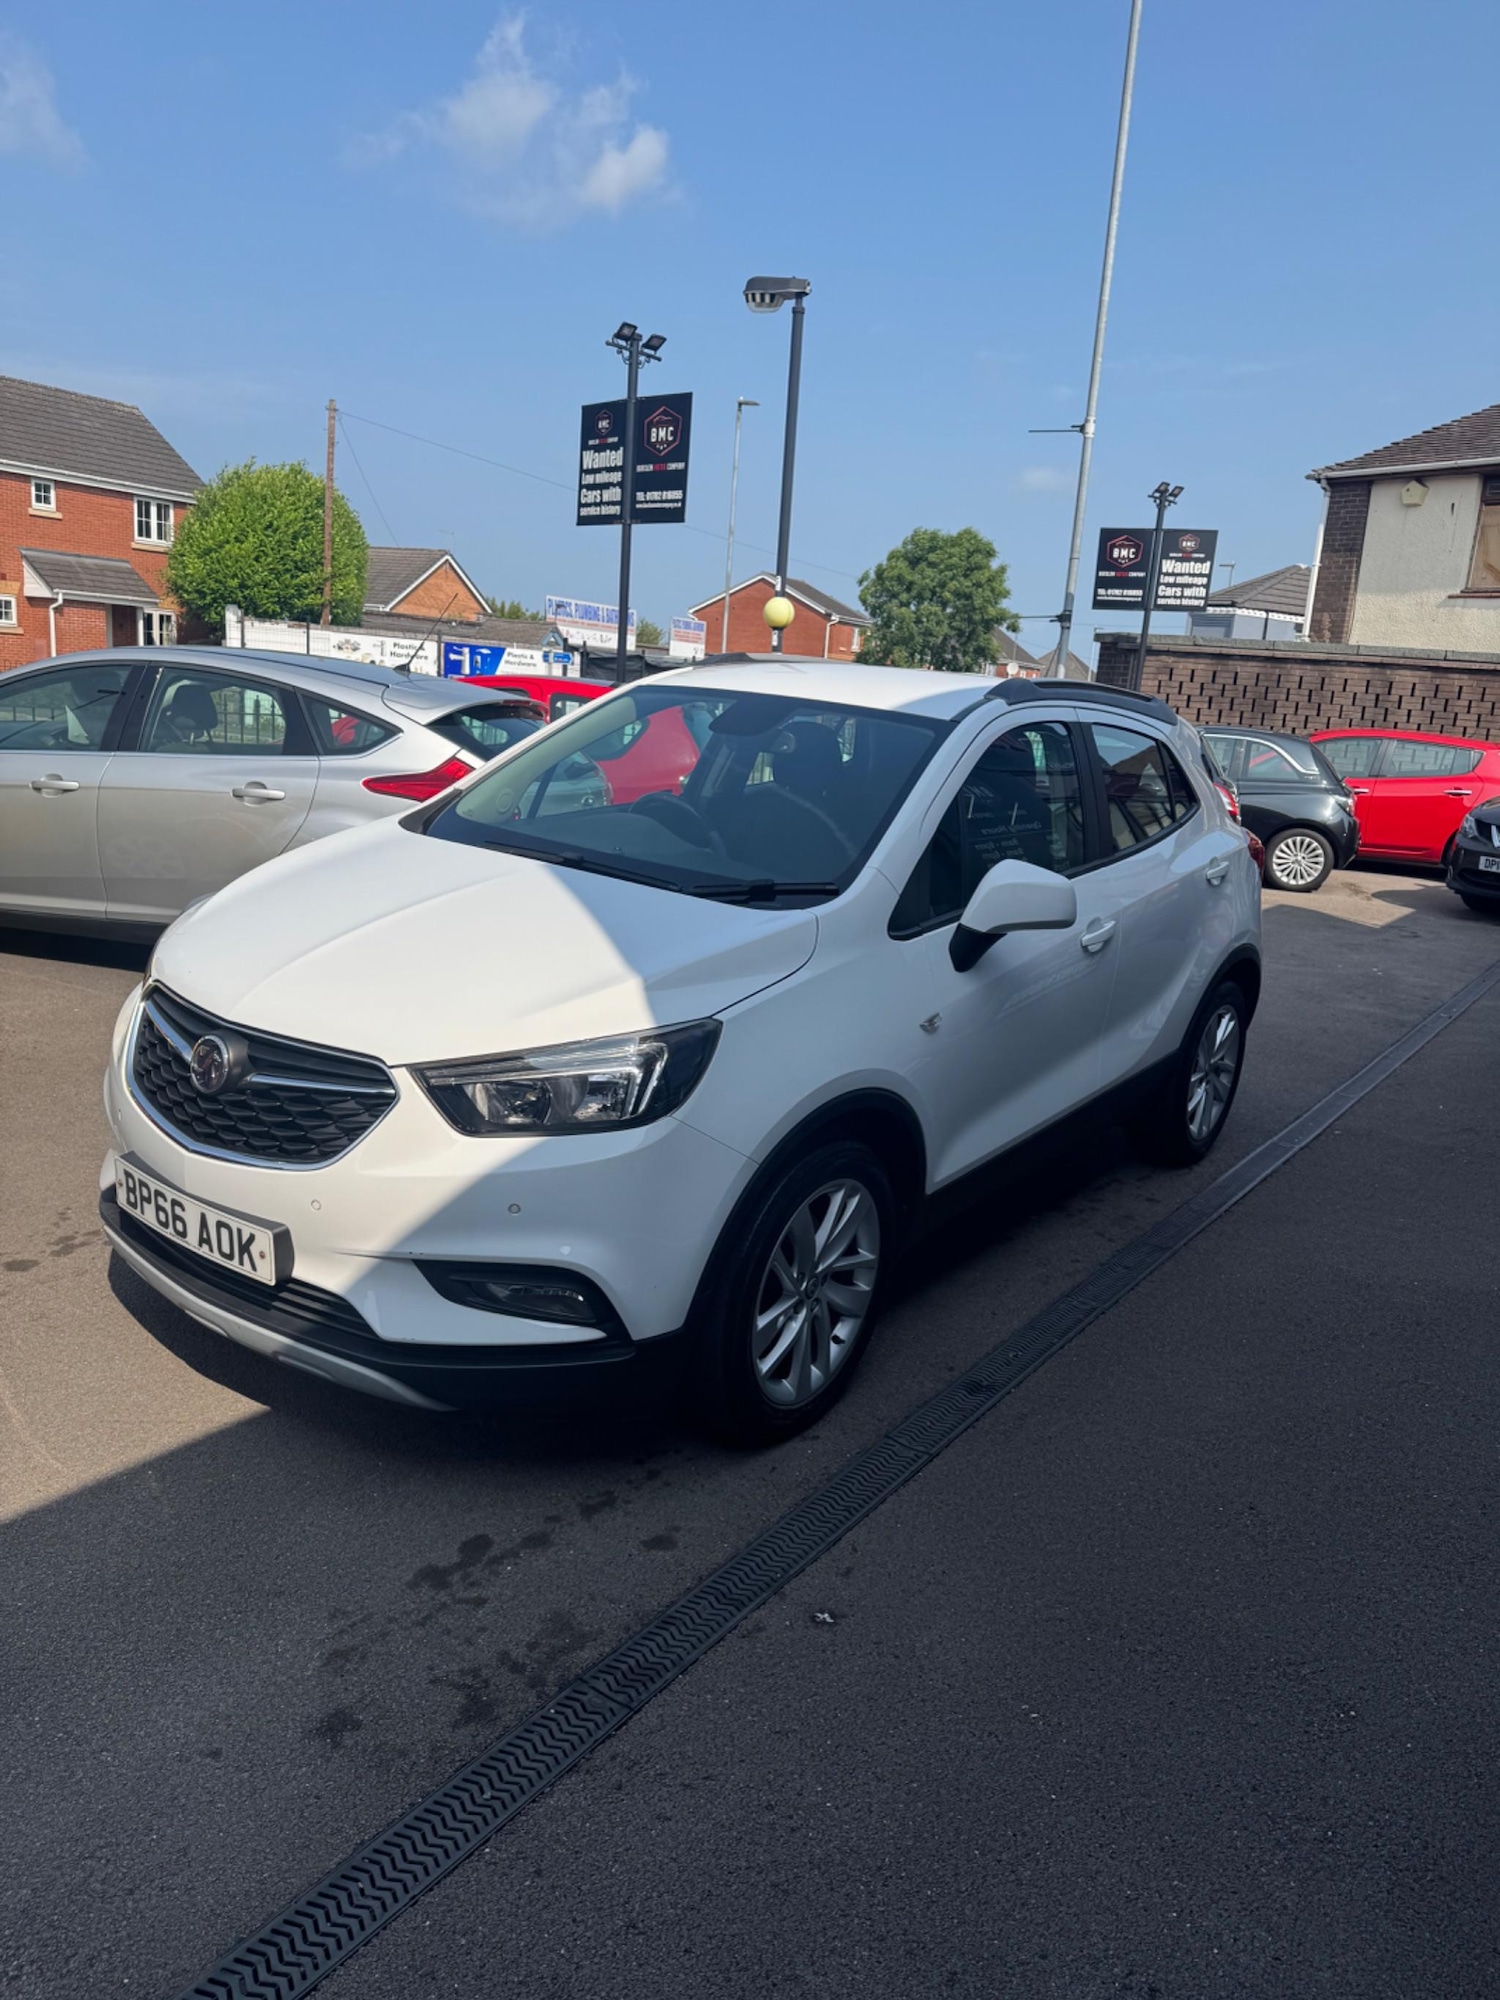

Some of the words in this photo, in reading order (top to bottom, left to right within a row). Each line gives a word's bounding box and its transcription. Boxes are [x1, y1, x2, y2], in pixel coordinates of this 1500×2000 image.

[650, 426, 674, 442] BMC
[582, 446, 624, 470] Wanted
[581, 473, 595, 485] Low
[595, 471, 622, 484] mileage
[580, 488, 601, 504] Cars
[602, 486, 622, 503] with
[579, 506, 600, 517] service
[600, 504, 621, 516] history
[1182, 540, 1196, 548] BMC
[1112, 548, 1136, 559] BMC
[1161, 559, 1211, 574] Wanted
[1160, 575, 1176, 584] Low
[1176, 575, 1208, 585] mileage
[1158, 585, 1182, 597] Cars
[1183, 586, 1207, 597] with
[1157, 597, 1180, 605] service
[1182, 598, 1205, 607] history
[393, 642, 417, 651] Plastic
[390, 650, 429, 660] Hardare
[504, 659, 537, 668] Hardware
[123, 1168, 188, 1240] BP66
[198, 1211, 257, 1272] AOK
